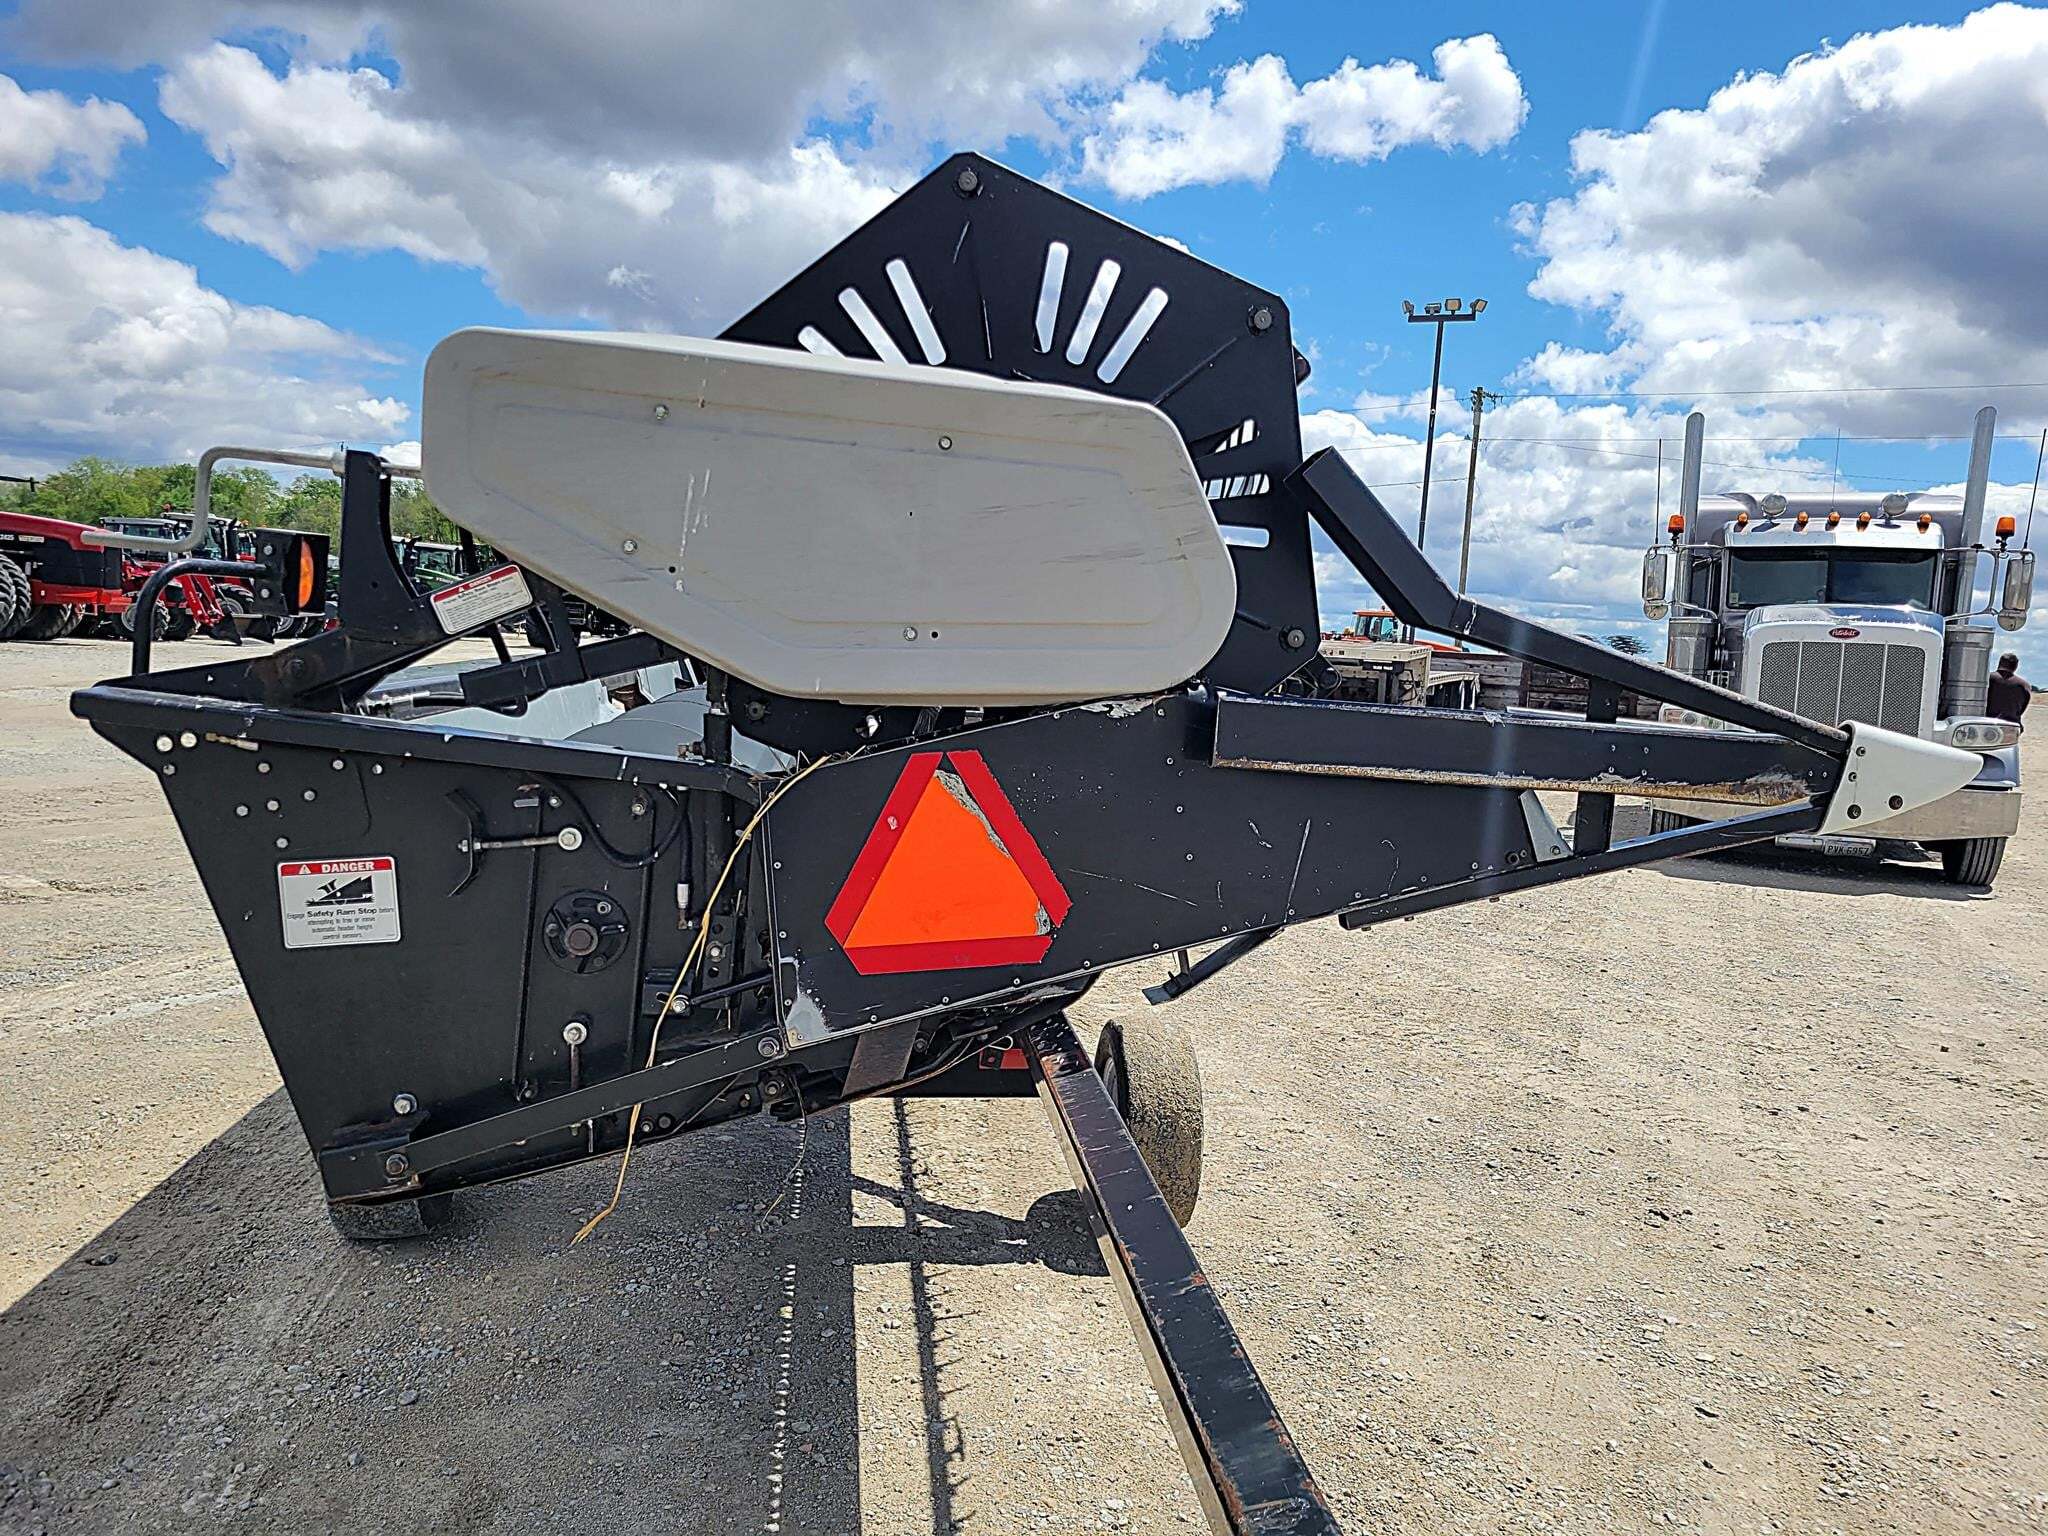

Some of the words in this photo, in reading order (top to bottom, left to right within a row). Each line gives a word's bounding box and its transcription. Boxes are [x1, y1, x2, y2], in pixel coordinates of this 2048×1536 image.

[321, 861, 375, 873] DANGER
[307, 910, 334, 918] Safety
[358, 907, 377, 915] Stop
